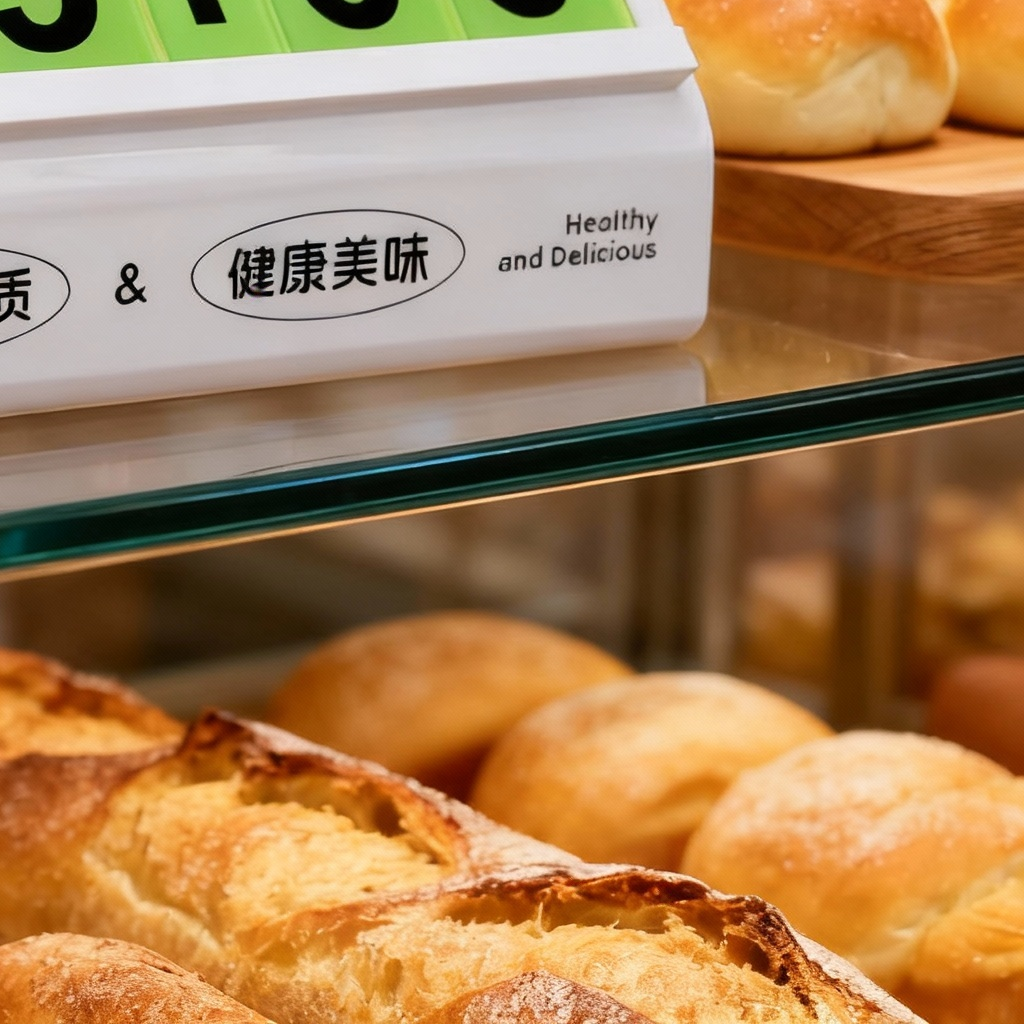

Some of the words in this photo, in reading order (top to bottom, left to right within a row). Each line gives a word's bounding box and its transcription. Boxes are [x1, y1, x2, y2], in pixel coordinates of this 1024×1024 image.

[565, 208, 659, 236] Healthy
[227, 231, 430, 300] 健康美味
[498, 244, 543, 273] and
[550, 241, 657, 268] Delicious
[114, 262, 148, 306] &
